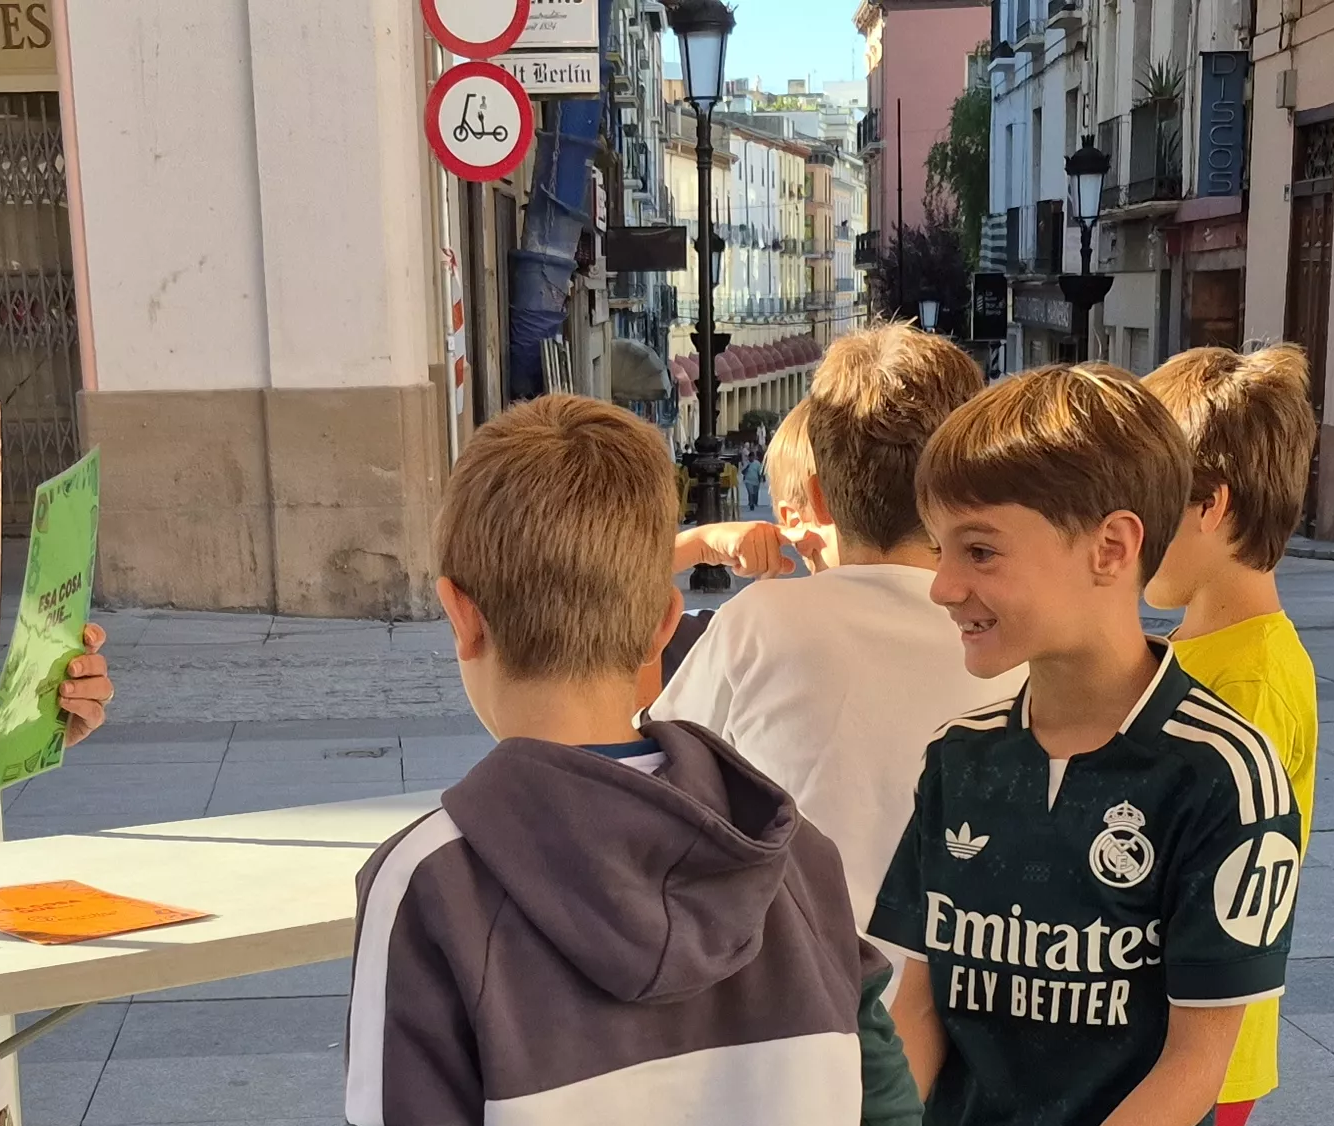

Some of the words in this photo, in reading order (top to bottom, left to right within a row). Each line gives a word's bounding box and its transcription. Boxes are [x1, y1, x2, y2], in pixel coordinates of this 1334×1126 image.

[499, 63, 525, 83] lt
[1207, 53, 1237, 193] DISCOS
[38, 588, 58, 614] ESA
[58, 571, 82, 603] COSA
[1227, 830, 1295, 948] hp
[924, 891, 1161, 973] Emirates
[949, 965, 999, 1013] FLY
[1010, 973, 1131, 1026] BETTER
